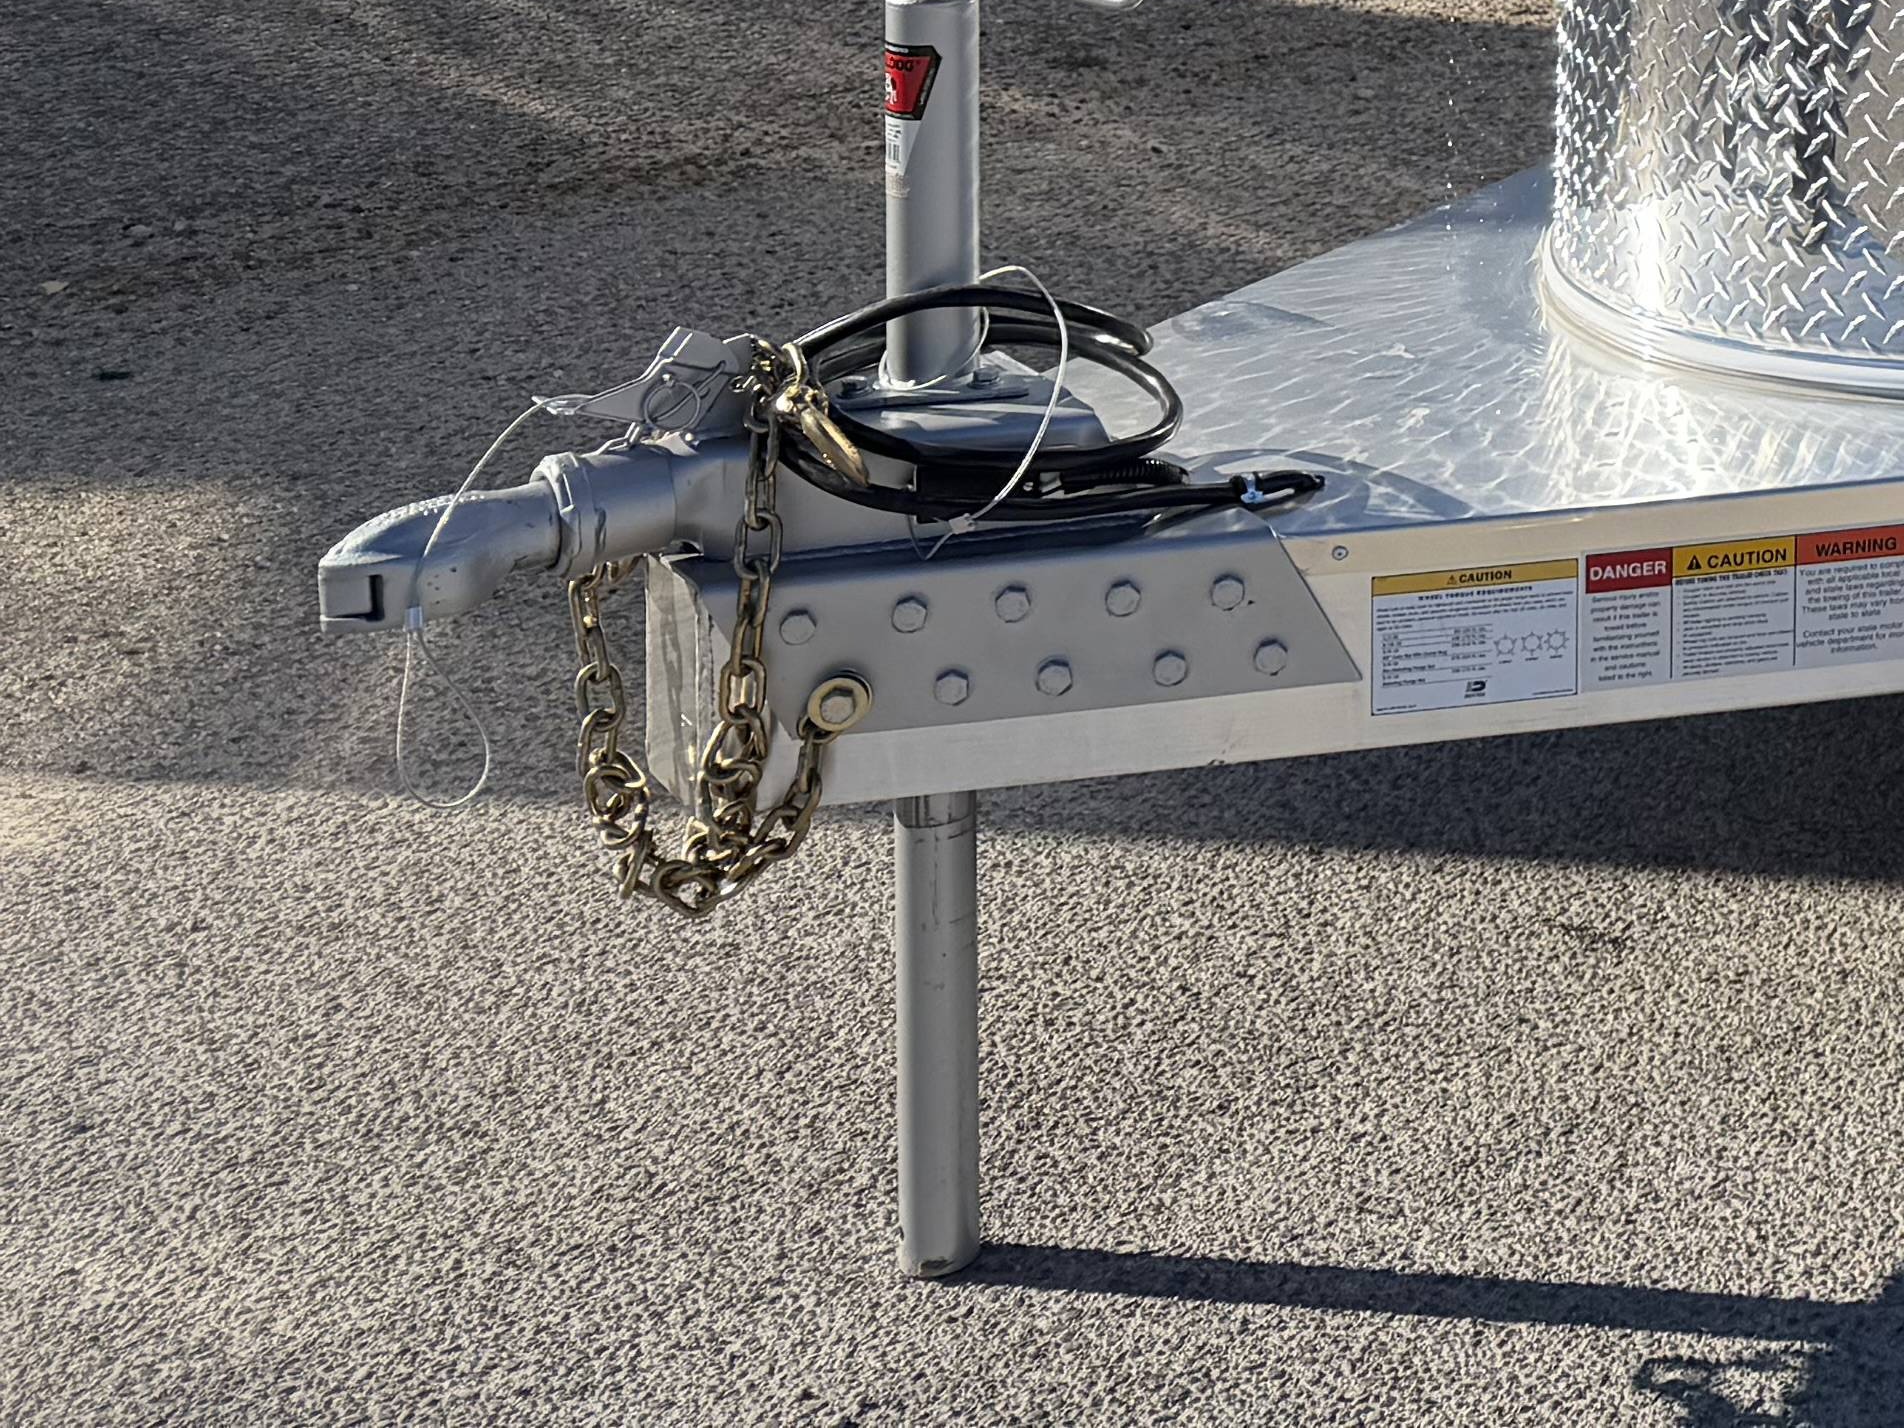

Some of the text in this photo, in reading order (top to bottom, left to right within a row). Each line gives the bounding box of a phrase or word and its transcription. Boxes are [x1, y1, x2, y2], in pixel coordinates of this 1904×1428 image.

[1815, 536, 1897, 557] WARNING
[1707, 547, 1787, 569] CAUTION
[1459, 570, 1512, 584] CAUTION
[1589, 560, 1667, 581] DANGER
